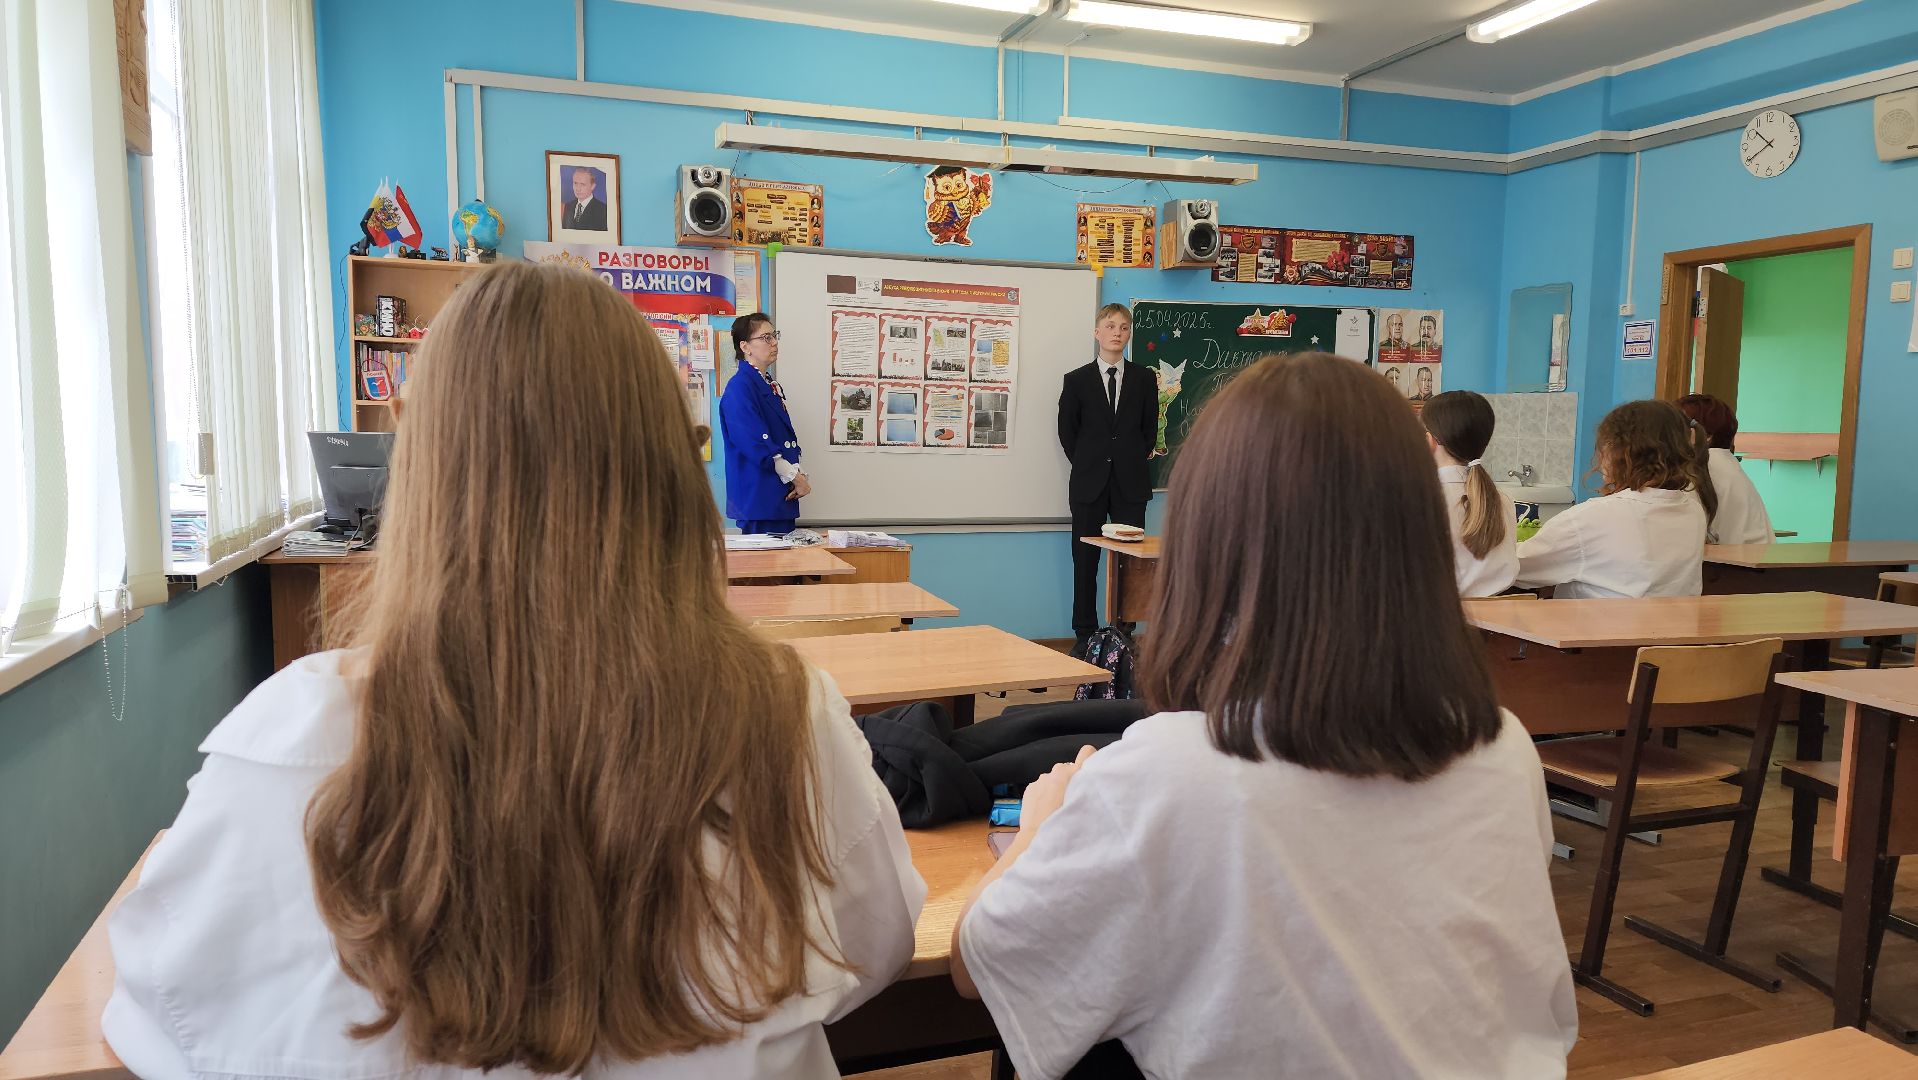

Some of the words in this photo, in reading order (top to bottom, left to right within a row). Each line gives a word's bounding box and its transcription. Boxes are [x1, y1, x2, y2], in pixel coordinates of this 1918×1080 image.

[1755, 116, 1761, 128] 11
[1766, 111, 1775, 123] 12
[1788, 121, 1796, 133] 2
[1746, 128, 1758, 141] 10
[1741, 142, 1749, 152] 9
[1792, 135, 1799, 147] 3
[1788, 150, 1795, 160] 4
[1755, 163, 1760, 174] 7
[1765, 165, 1773, 177] 6
[598, 251, 709, 271] РАЗГОВОРЫ
[621, 272, 711, 293] ВАЖНОМ
